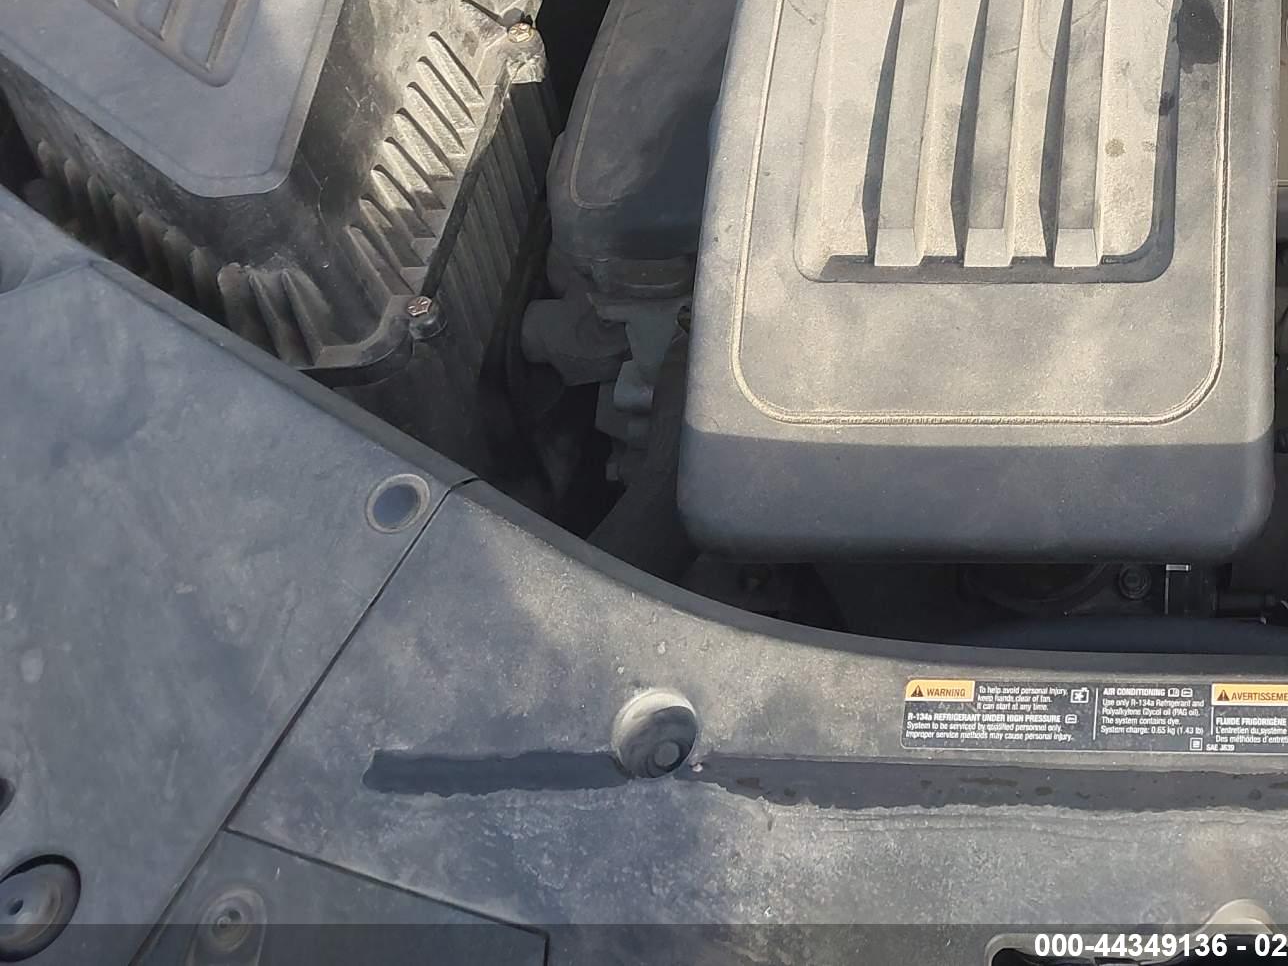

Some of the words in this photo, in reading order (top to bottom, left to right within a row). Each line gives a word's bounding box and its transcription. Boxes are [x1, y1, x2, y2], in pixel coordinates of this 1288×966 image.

[927, 688, 966, 697] WARNING
[987, 687, 1000, 695] help
[1021, 688, 1047, 696] personal
[1116, 699, 1128, 708] only
[1156, 700, 1190, 708] Refrigerant
[1143, 708, 1161, 716] Glycol
[1025, 715, 1060, 723] PRESSURE
[1115, 718, 1137, 726] system
[1167, 718, 1180, 726] dye.
[1015, 724, 1046, 732] personnel
[1101, 726, 1124, 734] System
[1167, 727, 1175, 735] kg
[1024, 732, 1051, 740] personal
[1054, 733, 1073, 741] injury.
